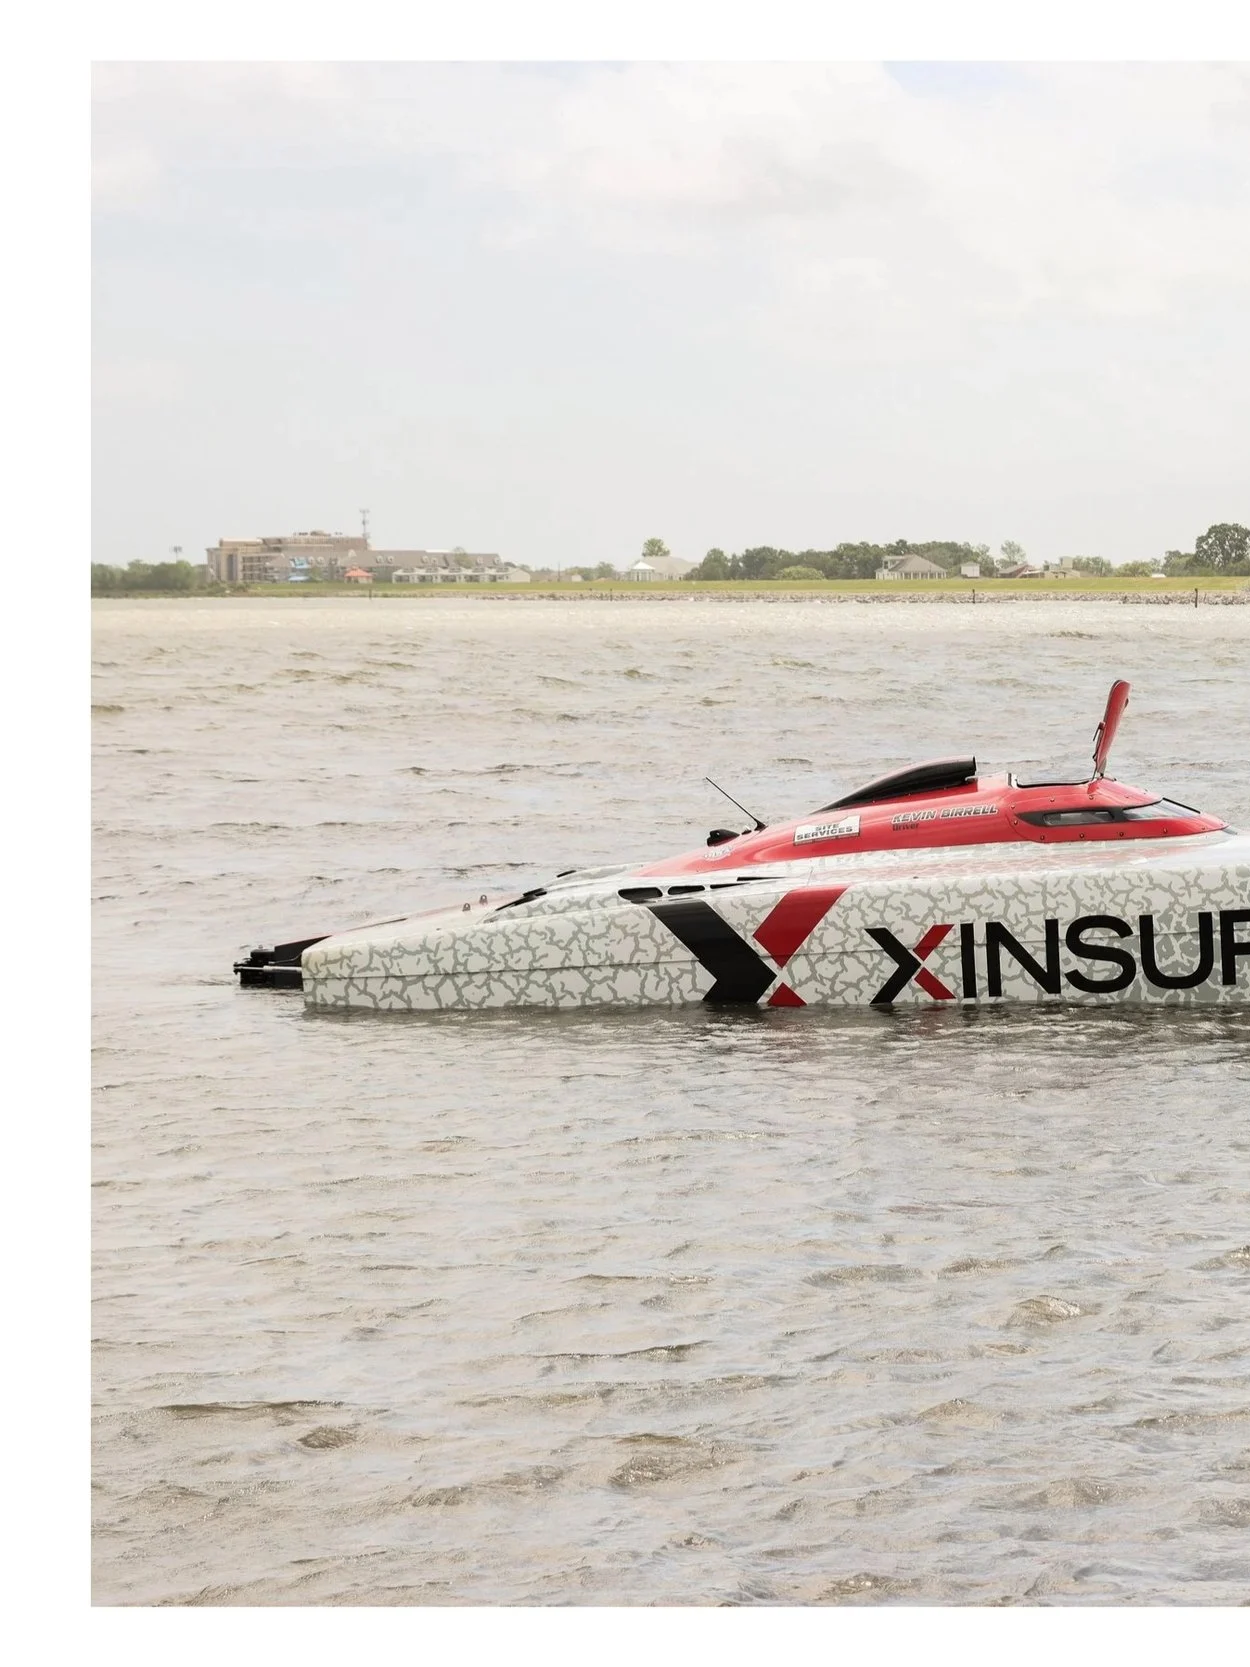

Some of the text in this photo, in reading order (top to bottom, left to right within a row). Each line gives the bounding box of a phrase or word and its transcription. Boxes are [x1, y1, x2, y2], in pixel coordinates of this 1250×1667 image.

[892, 804, 998, 823] KEVIN BIRRELL
[796, 826, 853, 840] SERVICES
[815, 823, 840, 831] SITE
